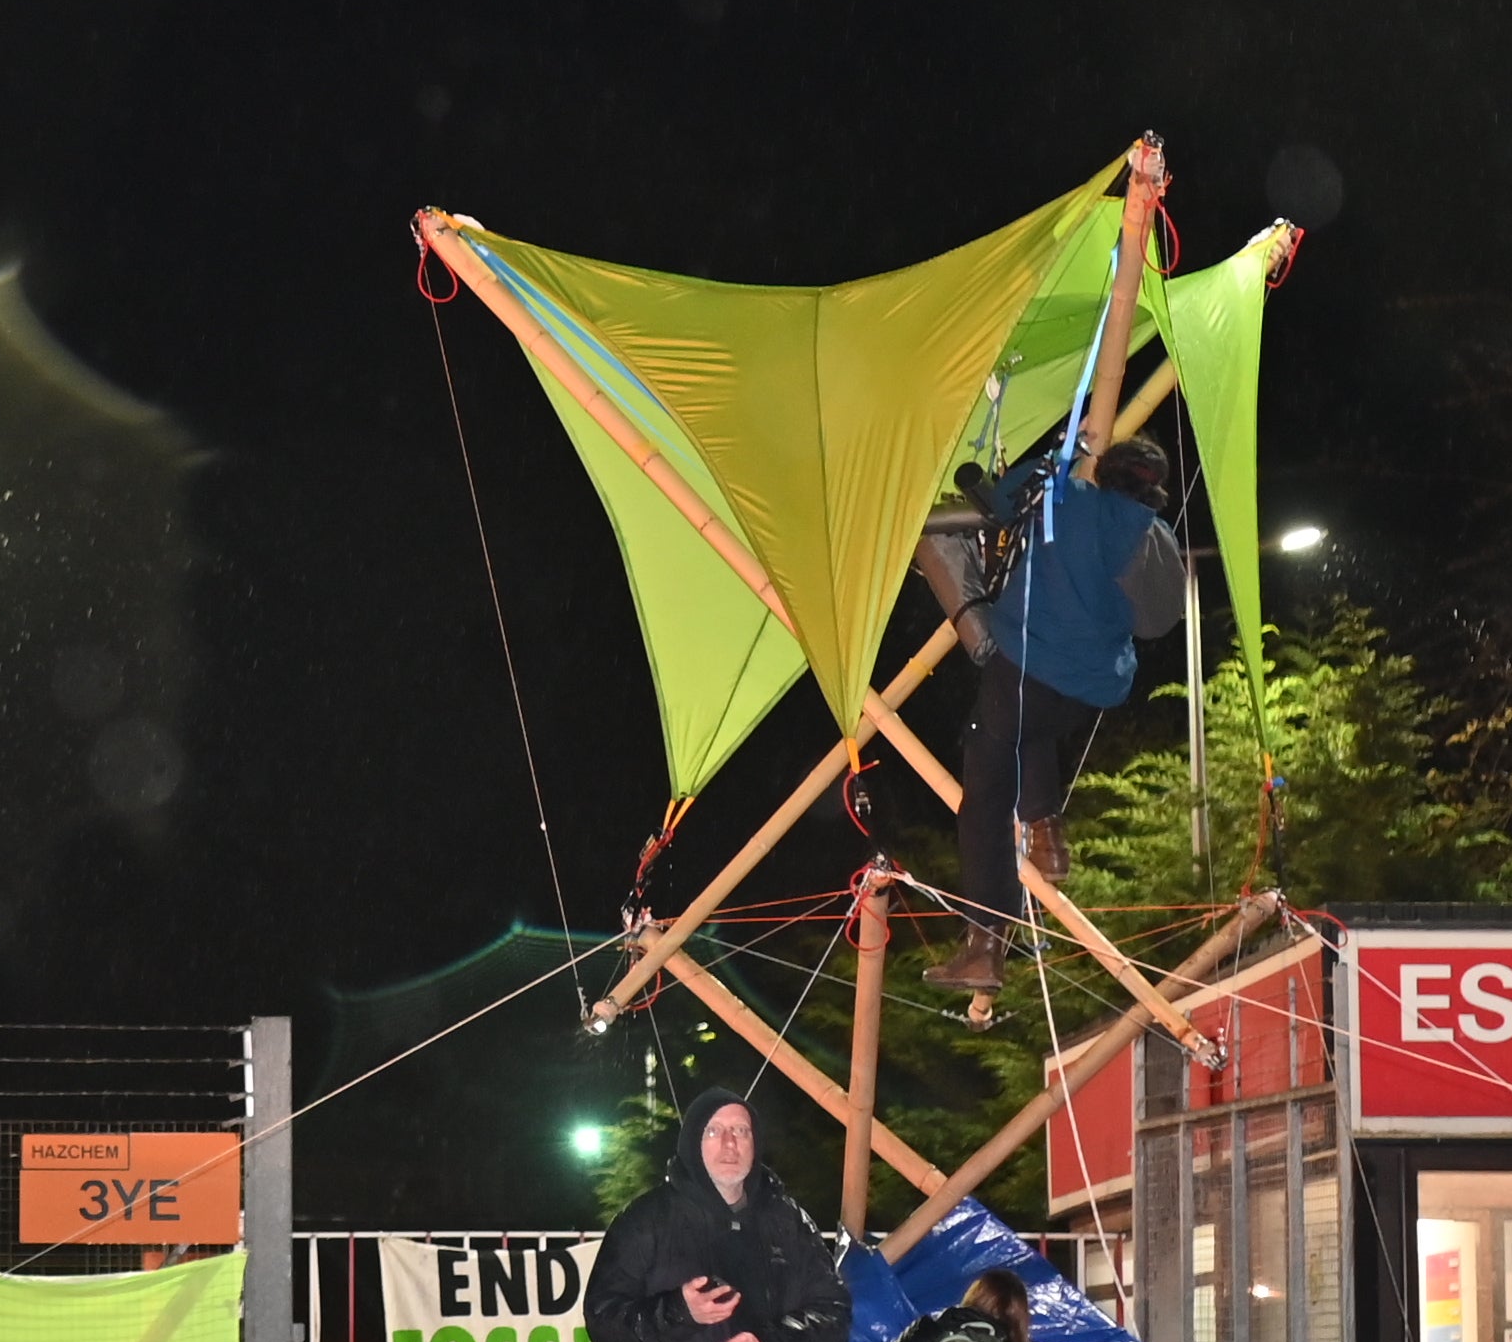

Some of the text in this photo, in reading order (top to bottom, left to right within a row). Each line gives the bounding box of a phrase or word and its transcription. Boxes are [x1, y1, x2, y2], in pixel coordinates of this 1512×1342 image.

[31, 1144, 119, 1159] HAZCHEM
[79, 1179, 181, 1222] 3YE
[437, 1249, 581, 1318] END
